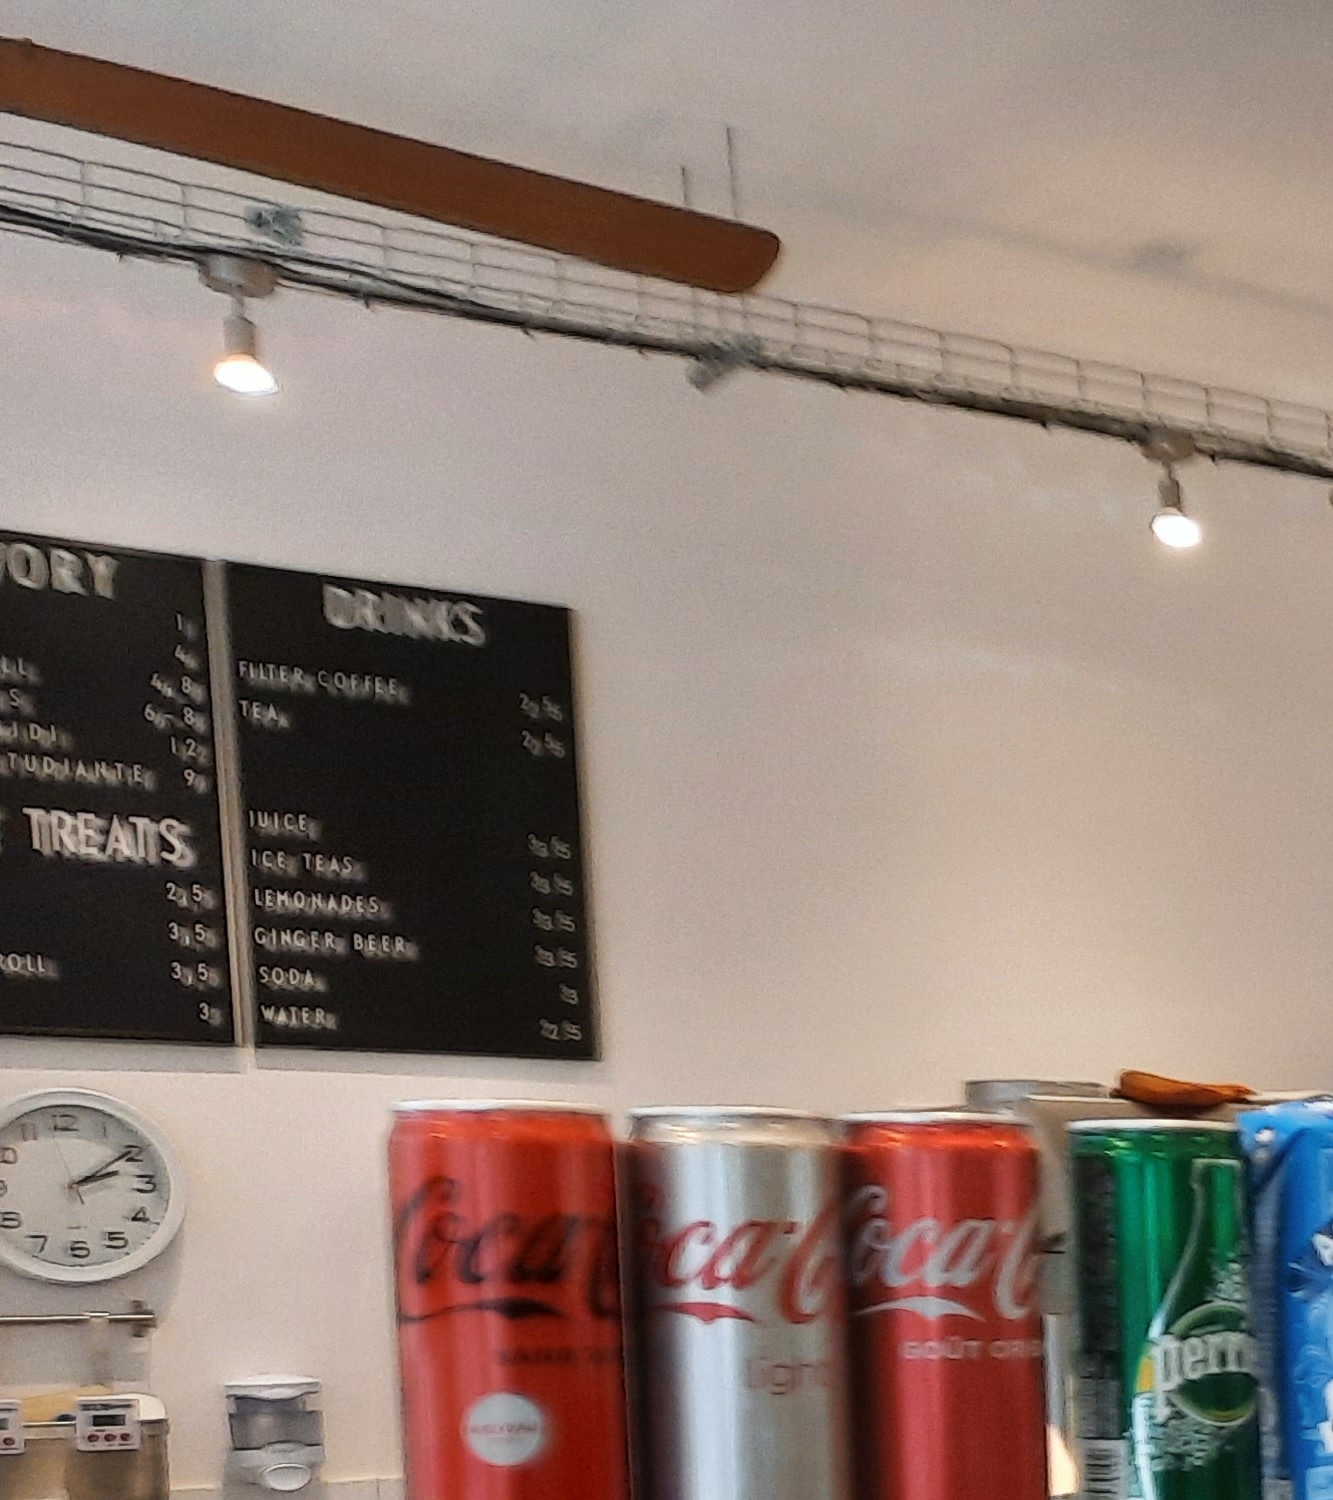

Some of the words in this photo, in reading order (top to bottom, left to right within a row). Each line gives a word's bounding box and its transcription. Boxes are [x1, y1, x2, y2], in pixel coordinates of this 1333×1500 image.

[238, 660, 305, 685] FILTER
[317, 669, 398, 695] COFFEE
[238, 699, 279, 721] TEA
[22, 806, 190, 865] TREATS
[251, 848, 287, 869] ICE
[302, 852, 353, 873] TEAS
[254, 888, 380, 914] LEMONADES
[254, 926, 337, 949] GINGER
[352, 932, 406, 954] BEER
[258, 965, 315, 986] SODA
[260, 1004, 327, 1025] WATER
[131, 1174, 157, 1194] 3
[129, 1205, 151, 1222] 4
[25, 1234, 48, 1253] 7
[105, 1231, 129, 1249] 5
